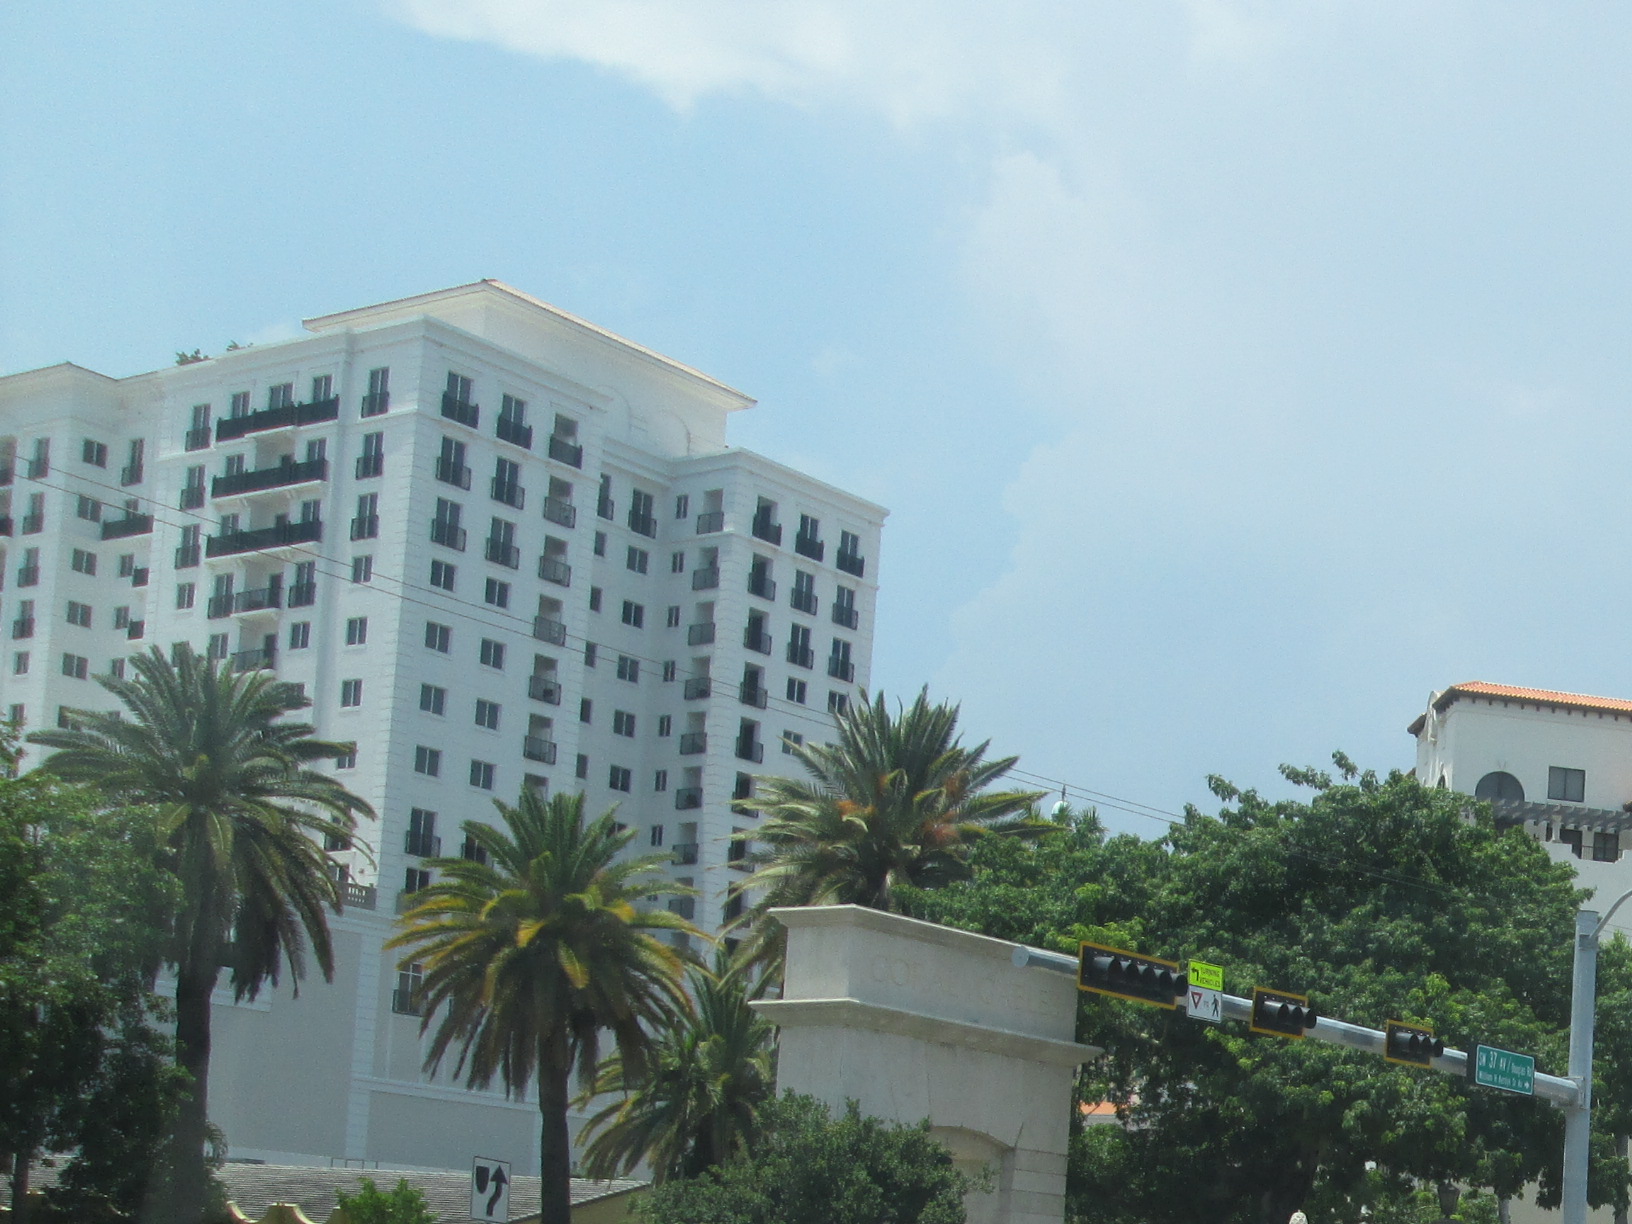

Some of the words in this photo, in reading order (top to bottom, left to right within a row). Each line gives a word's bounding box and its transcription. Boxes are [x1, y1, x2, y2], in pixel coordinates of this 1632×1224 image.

[1200, 967, 1220, 978] TURNING
[1199, 977, 1221, 988] VEHICLES
[1489, 1050, 1498, 1069] 37
